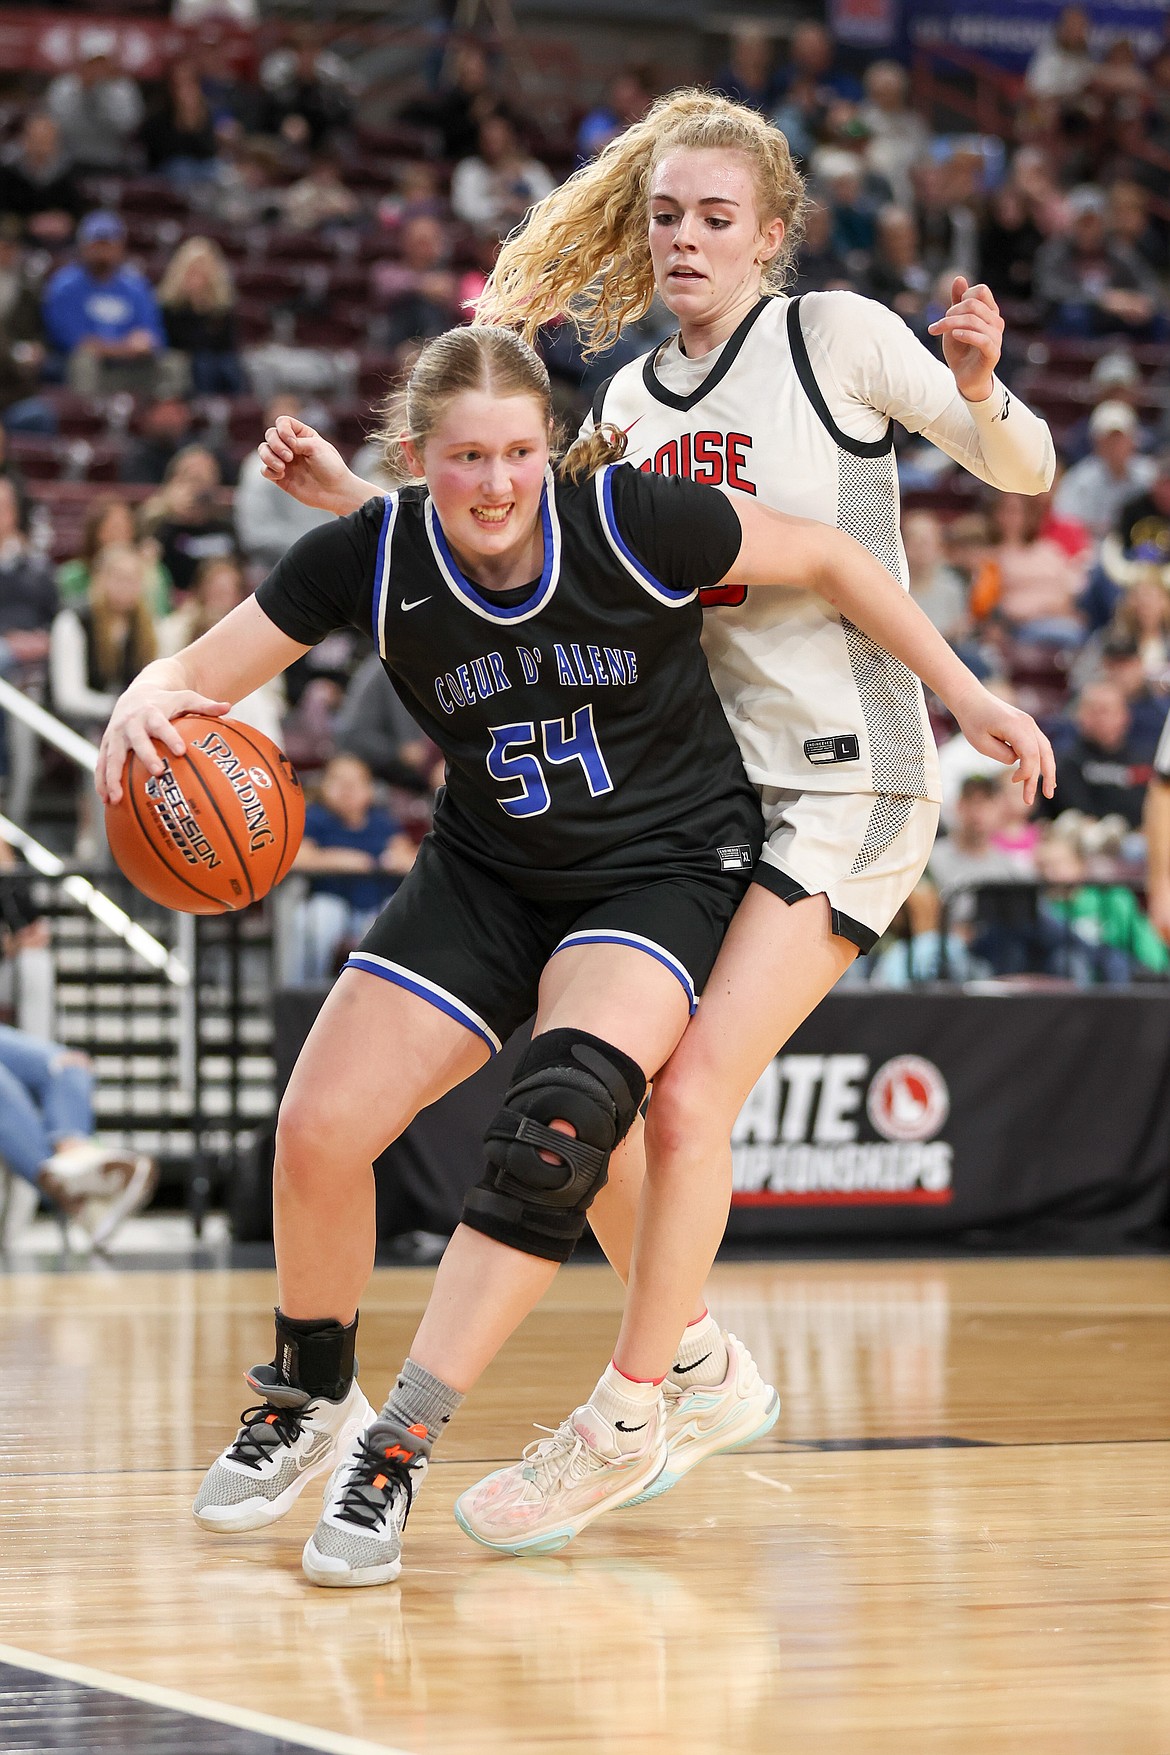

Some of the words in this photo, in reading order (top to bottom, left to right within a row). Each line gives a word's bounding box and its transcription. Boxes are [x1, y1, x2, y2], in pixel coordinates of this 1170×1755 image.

[435, 651, 512, 714] COEUR
[516, 646, 542, 685] D'
[553, 643, 639, 686] ALENE
[485, 703, 614, 819] 54
[841, 743, 850, 754] L
[191, 731, 275, 853] SPALDING
[154, 801, 200, 866] 1000
[741, 851, 750, 862] XL
[731, 1053, 870, 1142] ATE
